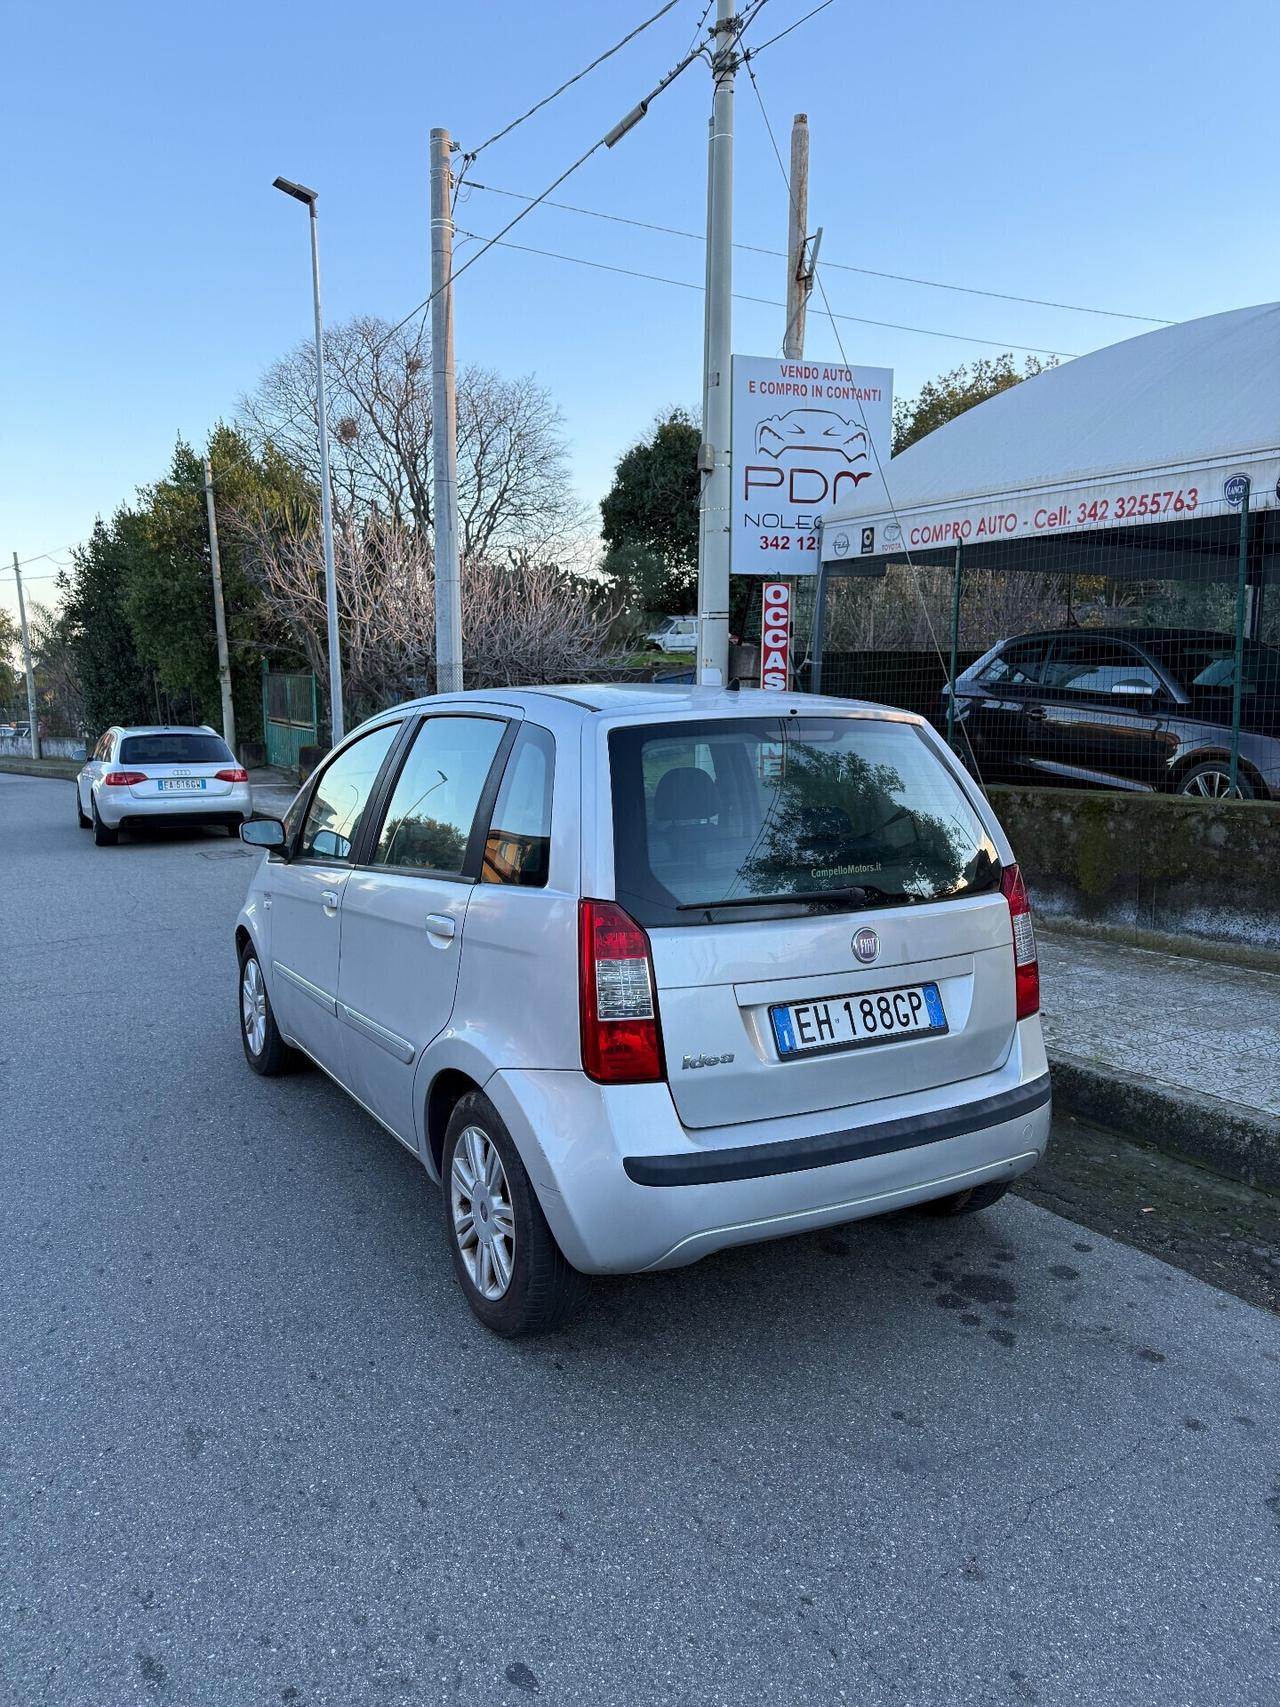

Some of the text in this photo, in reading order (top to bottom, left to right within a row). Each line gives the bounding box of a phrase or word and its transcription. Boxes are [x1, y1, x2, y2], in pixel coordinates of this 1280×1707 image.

[780, 364, 852, 382] VENDO AUTO
[749, 381, 882, 402] E COMPRO IN CONTANTI
[910, 520, 972, 546] COMPRO
[976, 512, 1018, 535] AUTO
[1033, 505, 1072, 530] Cell:
[1077, 500, 1110, 524] 342
[1114, 487, 1199, 520] 3255763
[759, 535, 790, 550] 342
[811, 861, 882, 879] CampelloMotors.it
[859, 937, 876, 955] FIAT
[794, 1003, 835, 1044] EH
[843, 991, 923, 1036] 188GP
